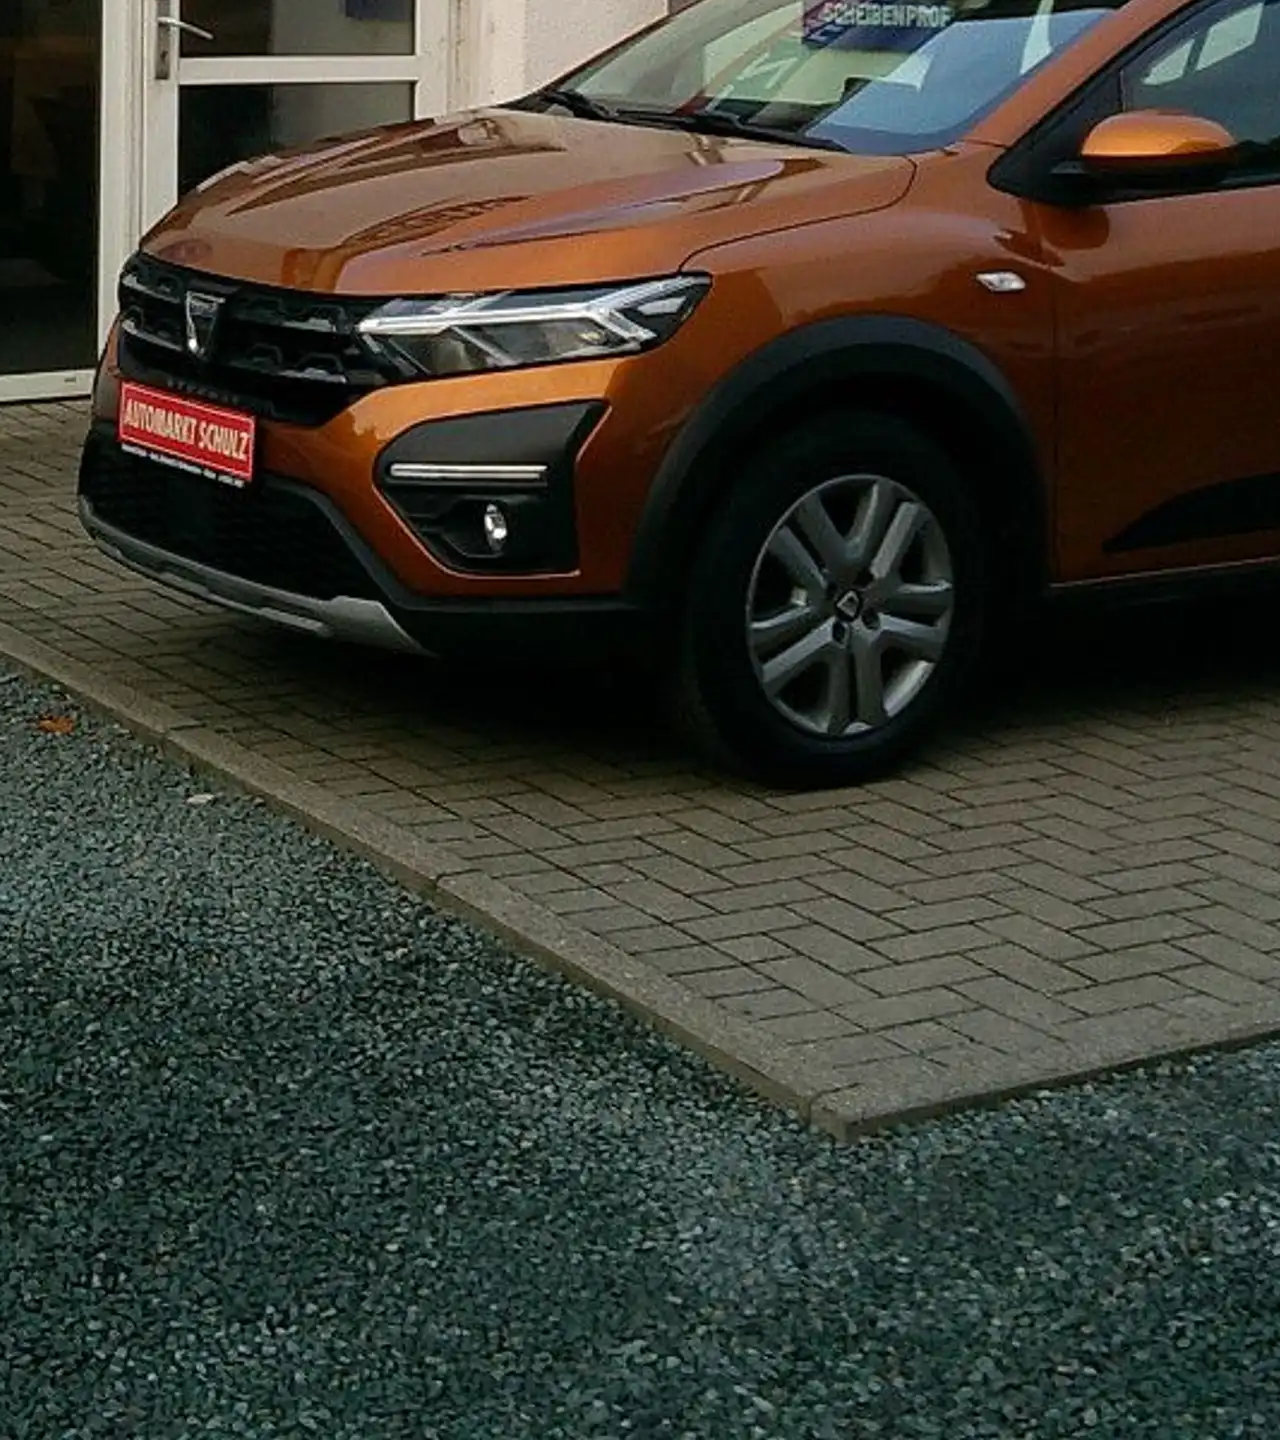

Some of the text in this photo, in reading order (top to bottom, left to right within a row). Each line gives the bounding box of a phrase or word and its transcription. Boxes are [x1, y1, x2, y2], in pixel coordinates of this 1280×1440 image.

[818, 2, 954, 28] SCHEIBENPROF
[123, 397, 250, 461] AUTOMARKT SCHULZ
